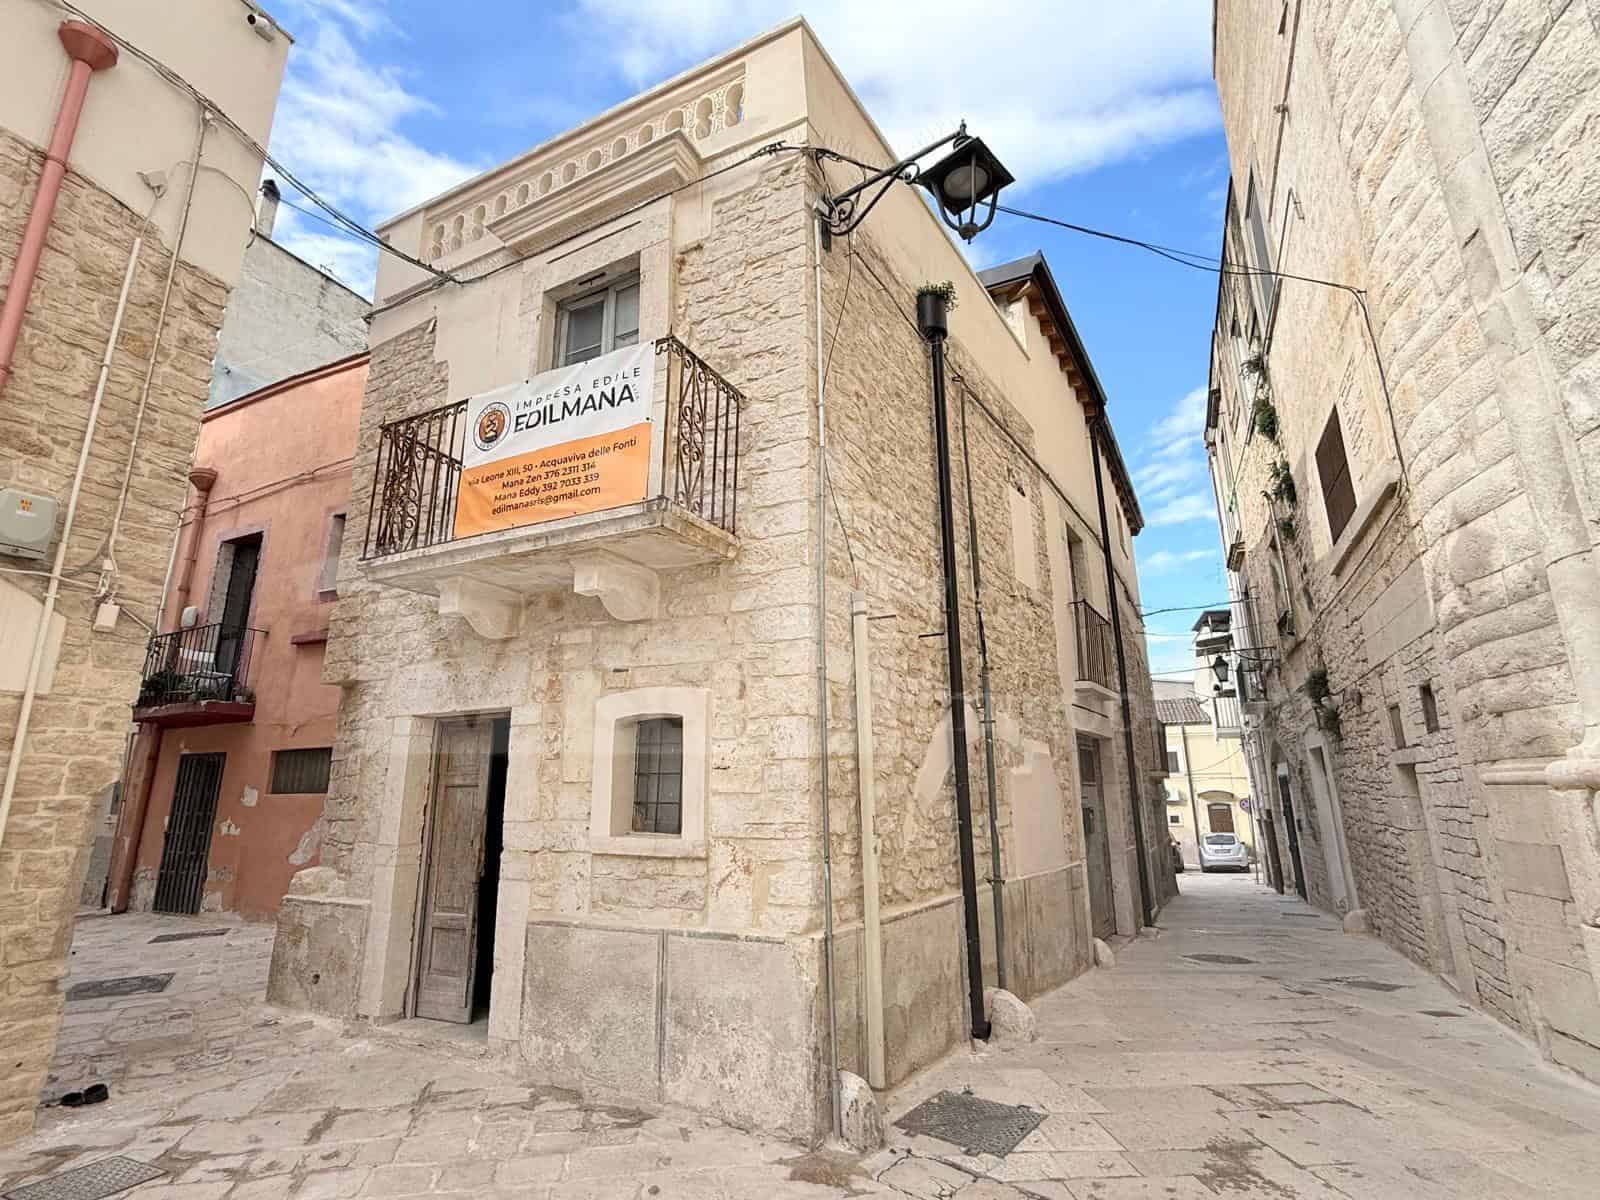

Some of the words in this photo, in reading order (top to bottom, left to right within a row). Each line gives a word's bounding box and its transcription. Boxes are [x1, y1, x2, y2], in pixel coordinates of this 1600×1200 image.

[513, 383, 635, 433] EDILMANA
[515, 384, 582, 411] IMPRESA
[592, 367, 641, 389] EDILE
[481, 472, 504, 484] Leone
[521, 463, 533, 473] 50
[539, 451, 586, 469] Acquaviva
[588, 445, 610, 457] delle
[612, 436, 637, 452] Fonti
[502, 478, 524, 489] Mana
[526, 474, 542, 484] Zen
[543, 469, 560, 480] 376
[561, 465, 579, 476] 2311
[581, 461, 596, 472] 314
[494, 491, 517, 502] Mana
[519, 486, 541, 498] Eddy
[542, 482, 558, 492] 392
[560, 477, 581, 488] 7033
[583, 472, 600, 484] 339
